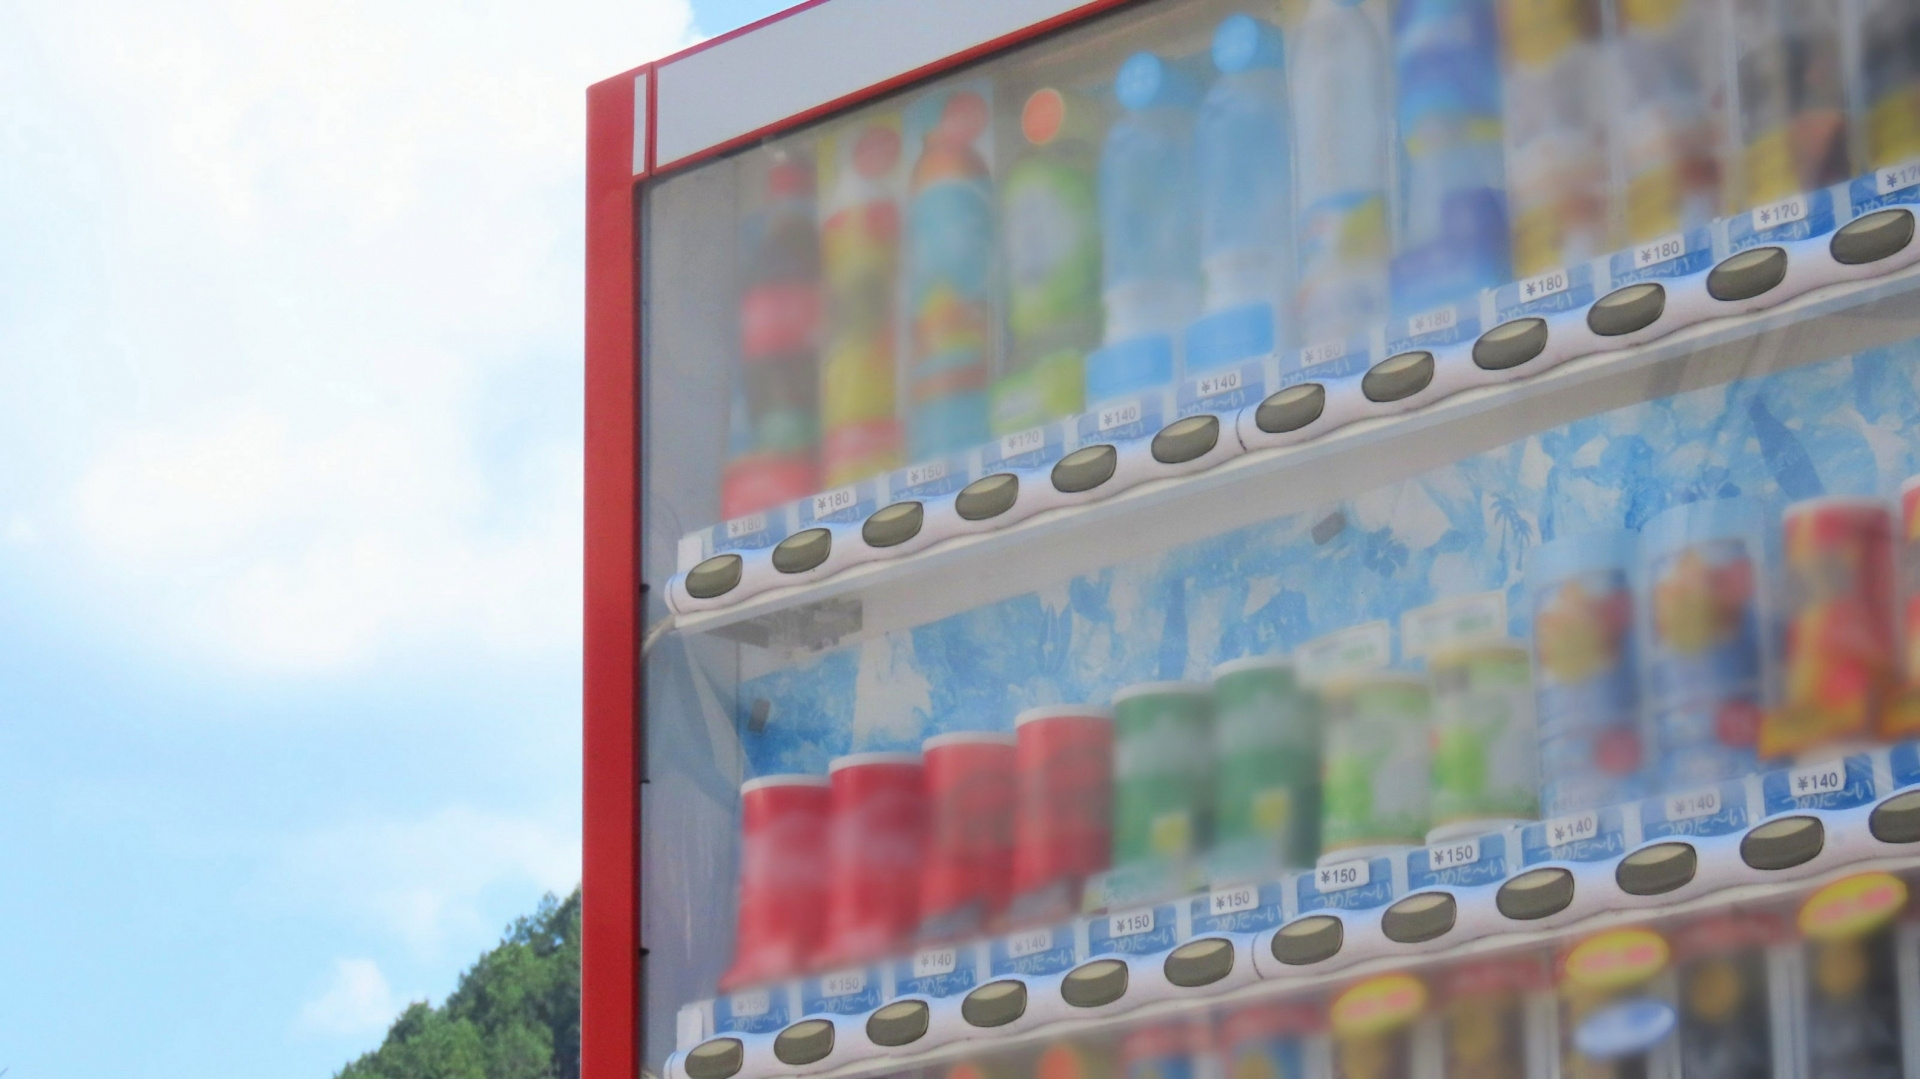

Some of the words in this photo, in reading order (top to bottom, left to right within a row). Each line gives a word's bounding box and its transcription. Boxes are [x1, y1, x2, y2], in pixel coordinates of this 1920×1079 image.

[1760, 202, 1799, 223] ¥170
[1641, 240, 1679, 263] ¥180
[1526, 275, 1563, 296] ¥180
[1415, 310, 1450, 330] ¥180
[1201, 374, 1236, 393] ¥140
[1104, 407, 1136, 426] ¥140
[1008, 430, 1039, 449] ¥170
[910, 463, 942, 482] ¥150
[817, 491, 849, 510] ¥180
[1797, 772, 1838, 790] ¥140
[1675, 794, 1715, 814] ¥140
[1555, 817, 1592, 841] ¥140
[1434, 845, 1473, 865] ¥150
[1321, 867, 1357, 884] ¥150
[1216, 890, 1250, 910] ¥150
[1117, 914, 1149, 932] ¥150
[1015, 934, 1046, 952] ¥140
[921, 953, 952, 968] ¥140
[829, 976, 859, 992] ¥150
